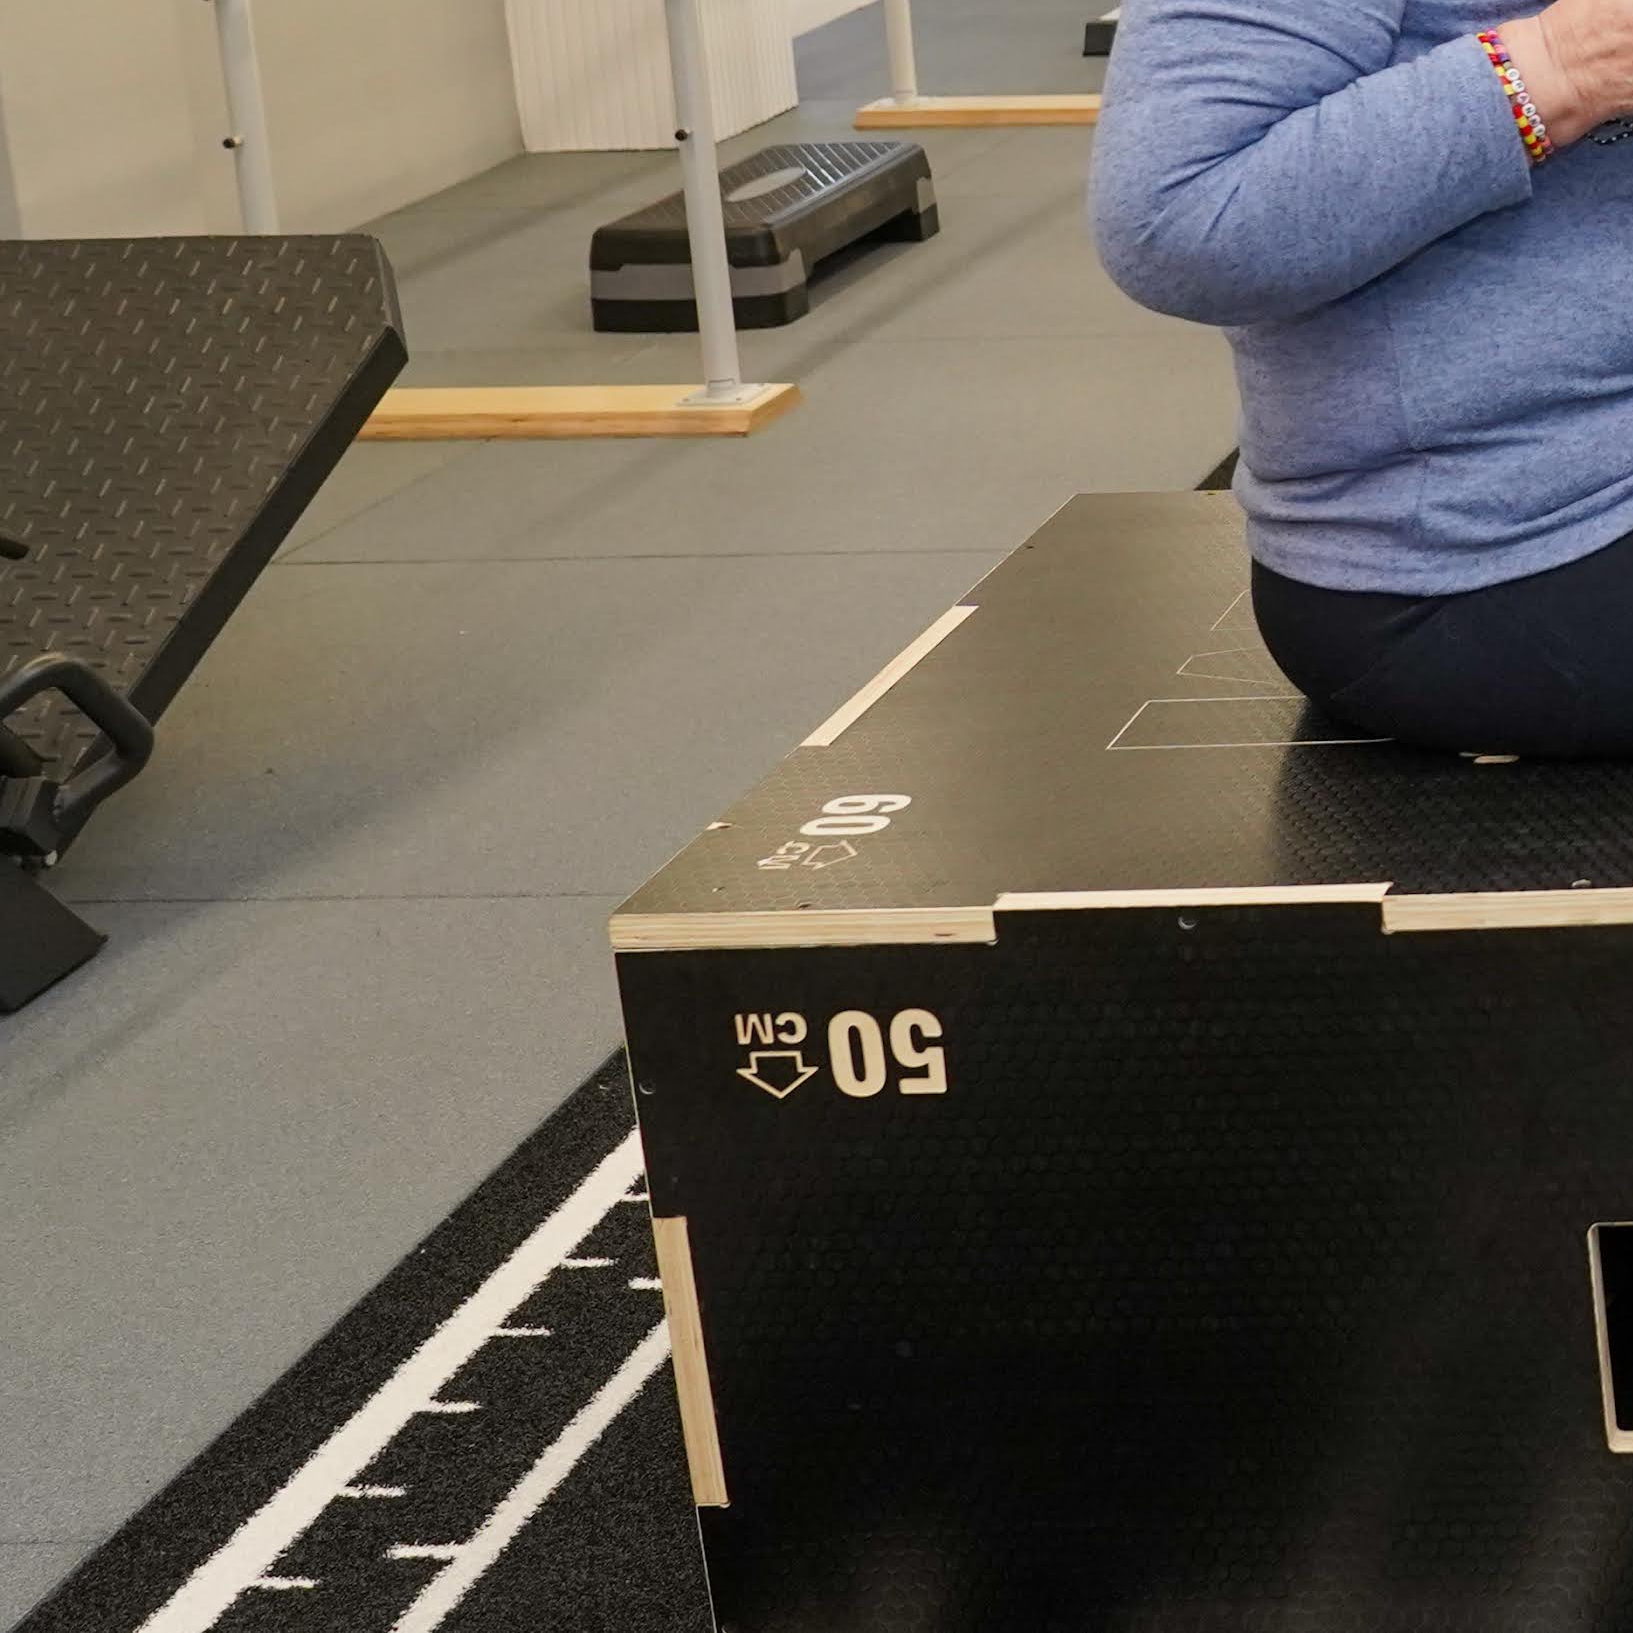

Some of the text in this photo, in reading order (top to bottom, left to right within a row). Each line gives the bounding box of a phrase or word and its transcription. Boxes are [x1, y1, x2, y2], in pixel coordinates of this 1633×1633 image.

[800, 794, 912, 836] 60
[733, 1008, 948, 1098] 50 CM
